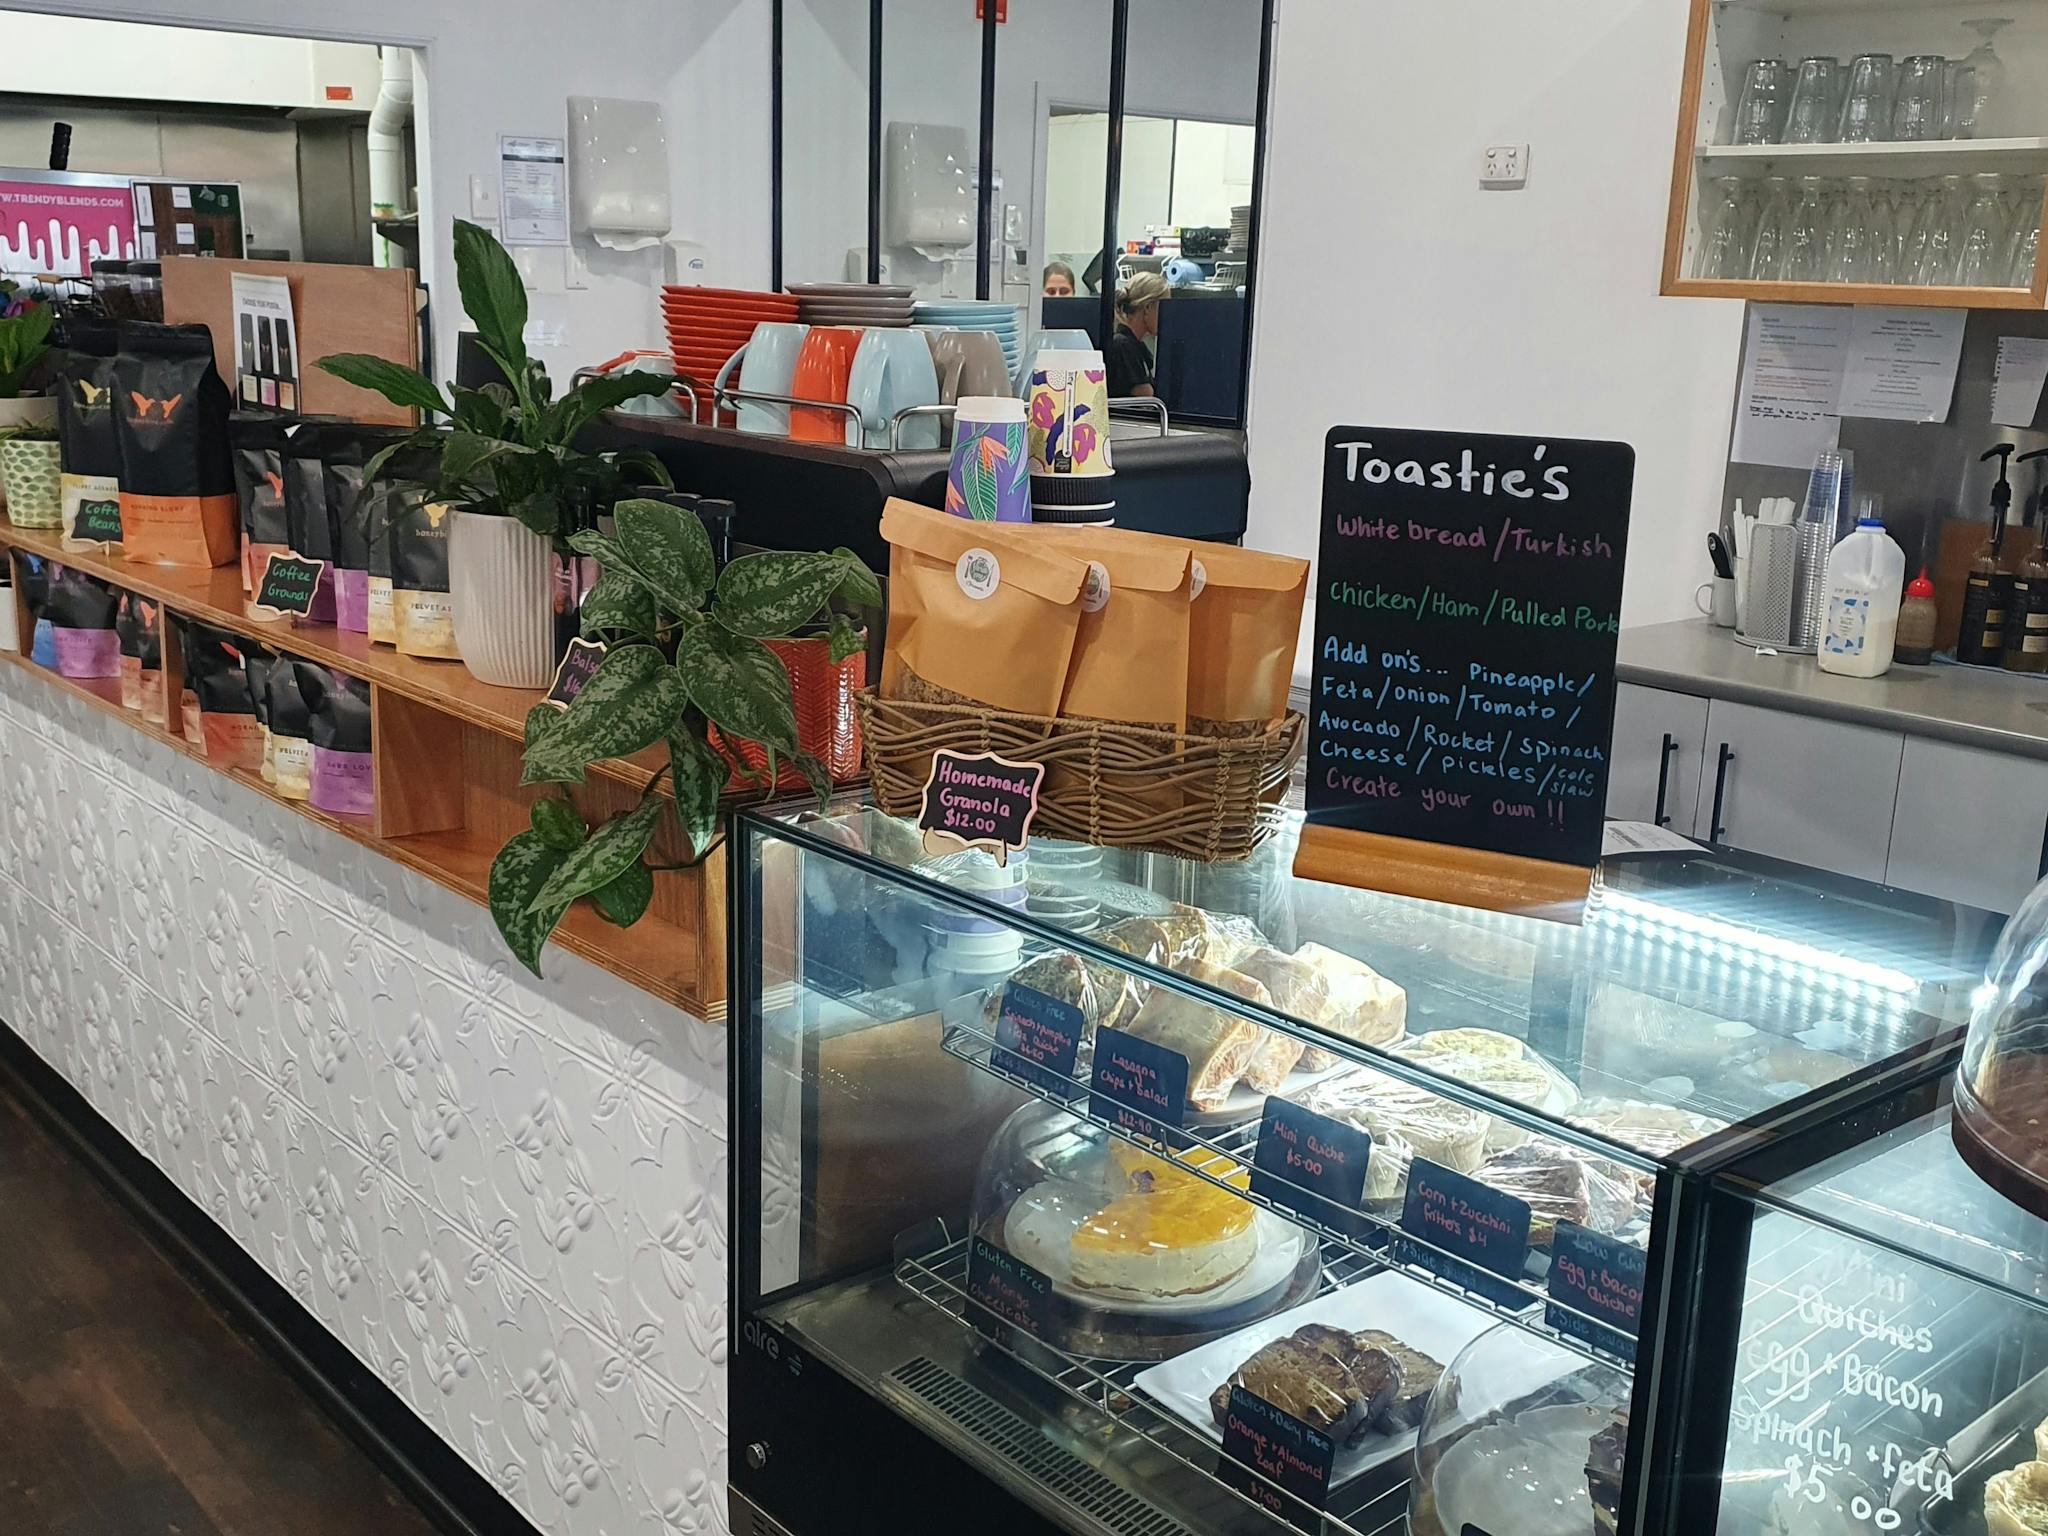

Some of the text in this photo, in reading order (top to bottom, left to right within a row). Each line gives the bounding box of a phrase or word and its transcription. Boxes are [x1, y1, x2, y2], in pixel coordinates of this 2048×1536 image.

[0, 193, 125, 209] W.TRENDYBLENDS.COM
[1334, 441, 1569, 500] Toastie's
[85, 503, 119, 516] Coffe
[1336, 513, 1400, 540] White
[1408, 519, 1487, 547] bread
[272, 563, 311, 581] Coffee
[268, 583, 309, 600] Grounds
[1574, 606, 1619, 635] Pork
[572, 649, 599, 674] Bals
[1323, 635, 1368, 665] Add
[352, 763, 371, 771] LOV
[939, 760, 1031, 798] Homemade
[940, 787, 1010, 817] Granola
[1326, 766, 1401, 798] Create
[1421, 788, 1473, 811] your
[1492, 799, 1536, 819] own
[944, 808, 996, 833] $12.00
[1111, 1052, 1157, 1087] Lasagna
[1100, 1069, 1126, 1091] Chips
[1136, 1084, 1169, 1108] Salad
[1273, 1120, 1345, 1164] Mini Quiche
[1418, 1180, 1446, 1206] Corn
[1468, 1226, 1487, 1248] $4
[976, 1242, 1045, 1294] Gluten Free
[1558, 1254, 1586, 1291] Egg
[1587, 1286, 1635, 1318] Quiche
[1842, 1353, 1943, 1418] Bacon
[1228, 1413, 1268, 1456] Orange
[1306, 1429, 1330, 1452] Free
[1732, 1396, 1852, 1466] Spinach
